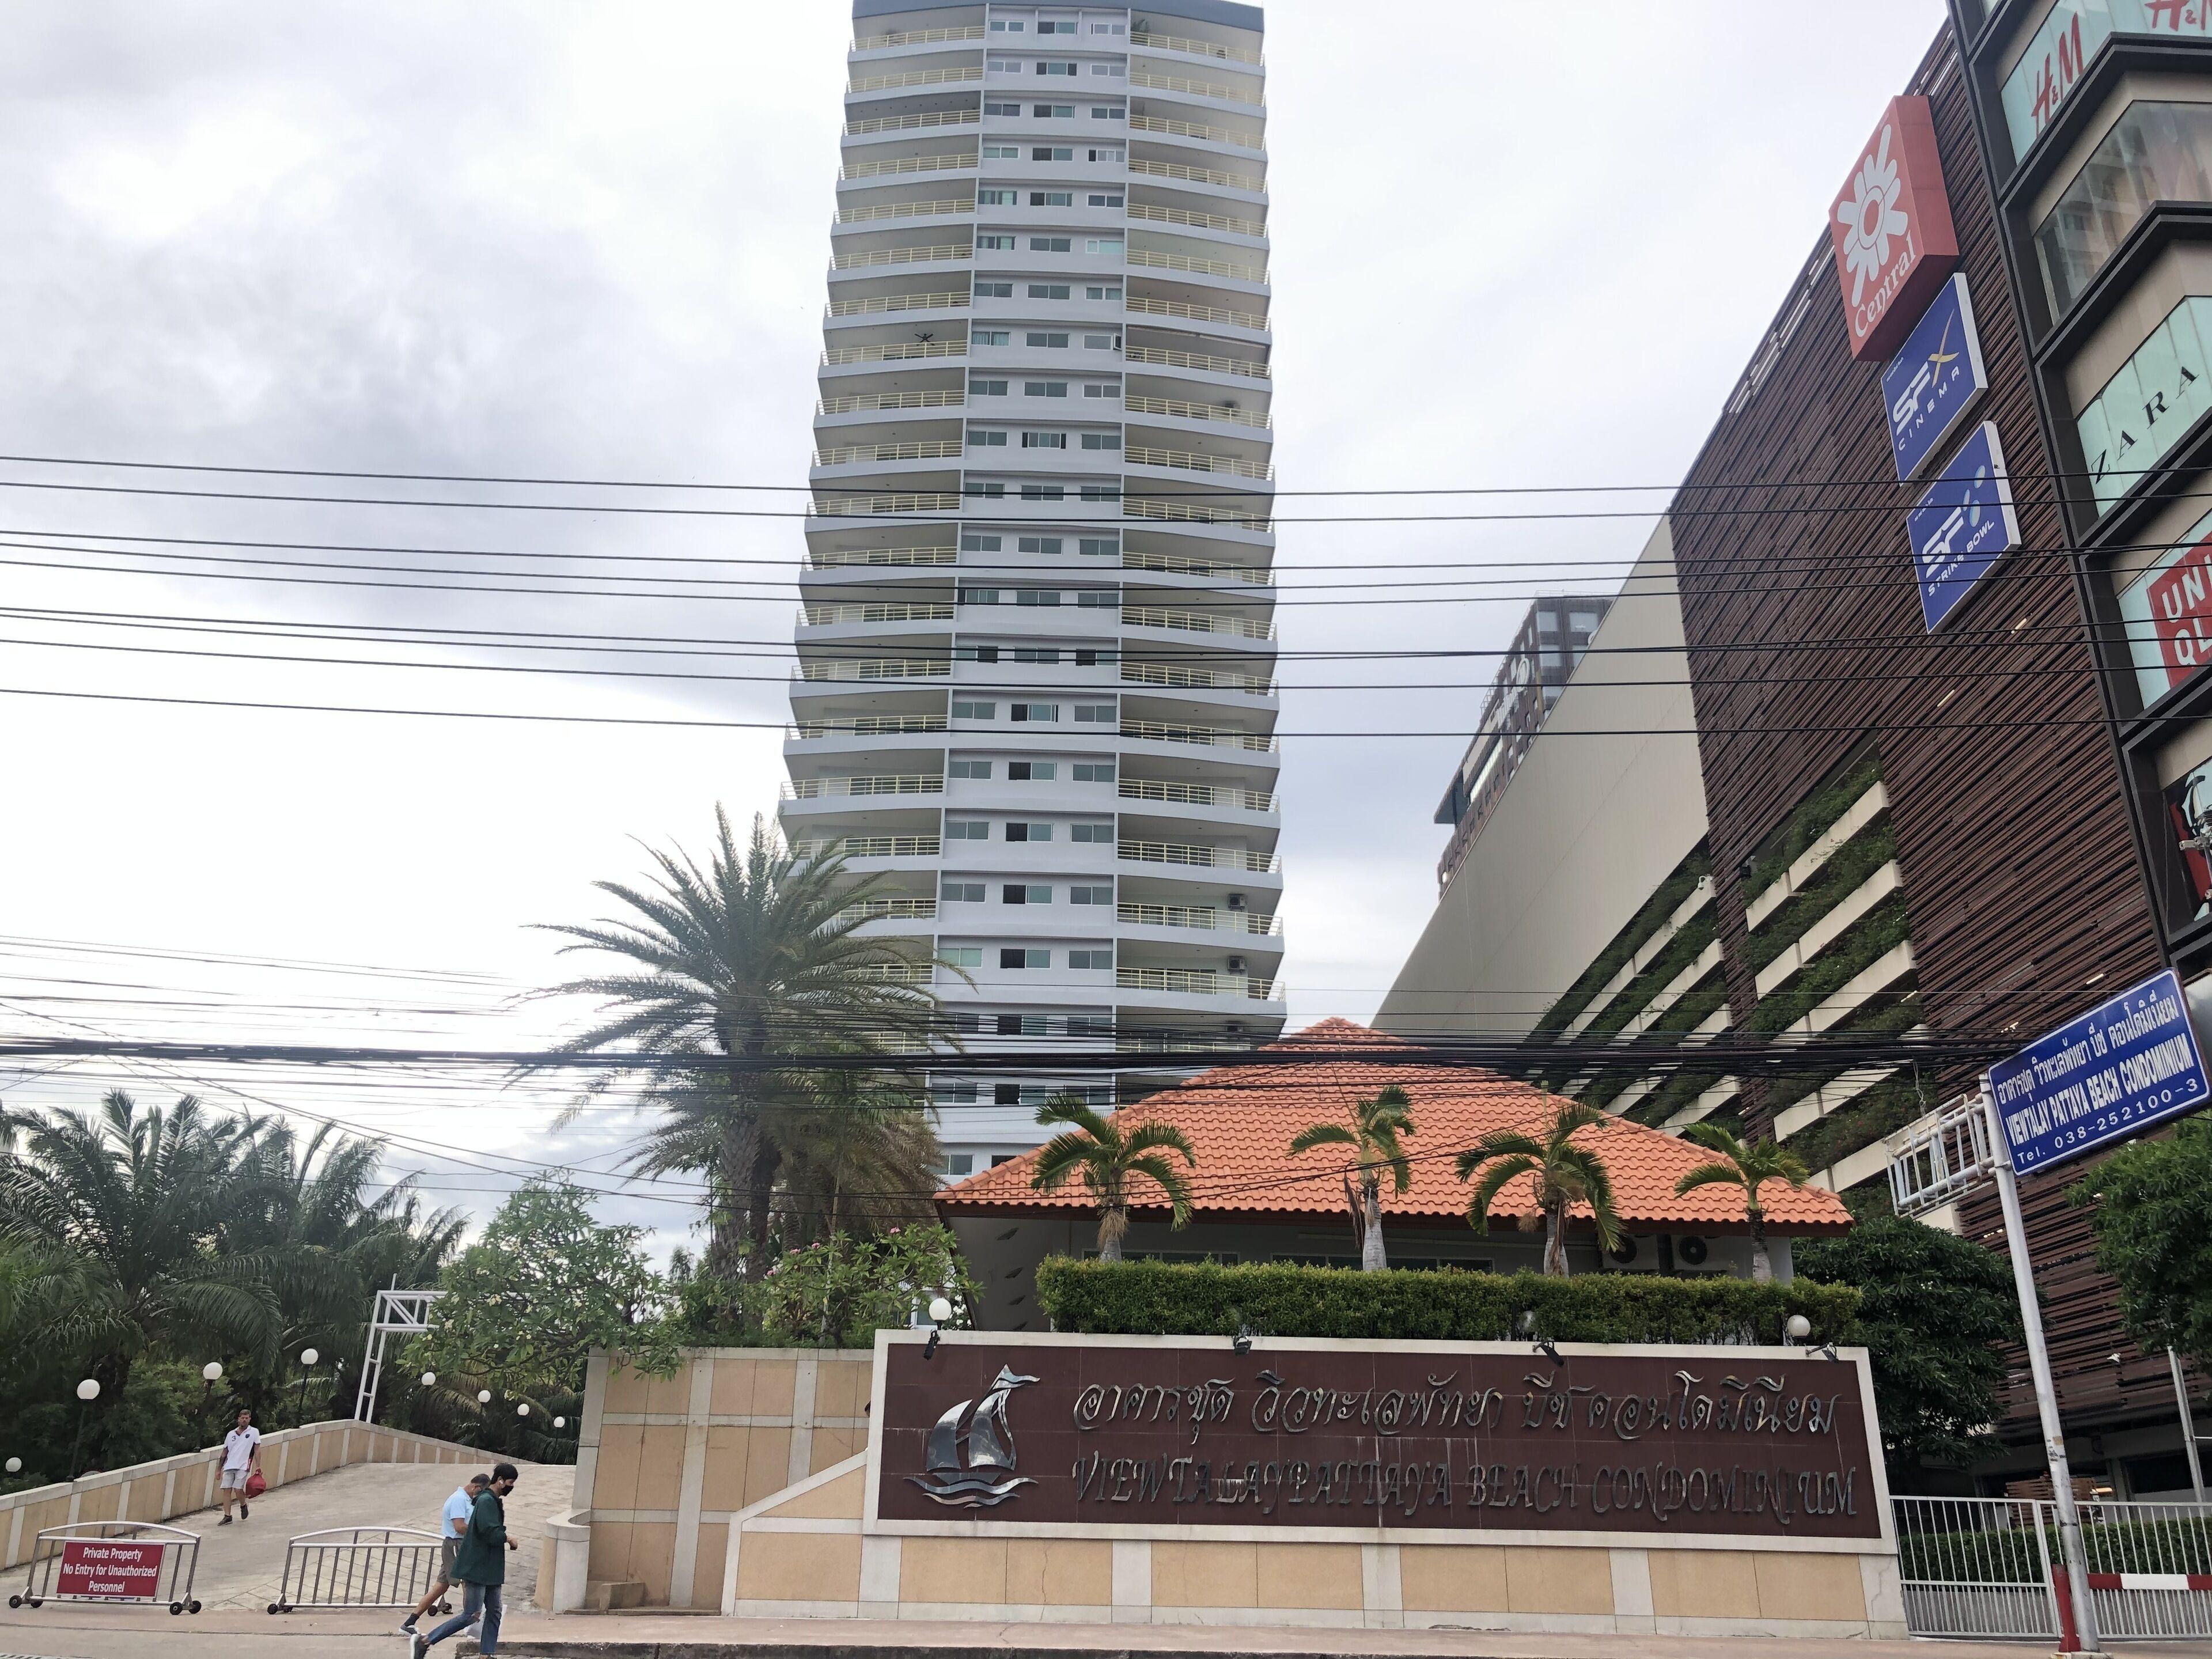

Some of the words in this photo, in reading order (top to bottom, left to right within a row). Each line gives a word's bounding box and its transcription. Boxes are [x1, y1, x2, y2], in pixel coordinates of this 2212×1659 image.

[1855, 229, 1916, 338] Central
[1898, 365, 1960, 451] CINEMA
[2090, 366, 2200, 485] ZARA
[1922, 506, 1964, 579] SF
[1927, 551, 1965, 597] STRIKE
[1966, 520, 1995, 554] BOWL
[1997, 1068, 2036, 1105] อาคารชุด
[2031, 1037, 2092, 1085] วิวทะเลพัทยา
[2088, 1022, 2108, 1058] บีช
[2108, 989, 2180, 1050] คอนโดมิเนียม
[2005, 1099, 2052, 1146] VIEWTALAY
[2048, 1082, 2092, 1128] PATTAYA
[2086, 1066, 2123, 1111] BEACH
[2119, 1032, 2195, 1095] CONDOMINIUM
[2017, 1146, 2046, 1164] Tel.
[1073, 1377, 1236, 1446] อาคารชุด
[1251, 1369, 1504, 1435] วิวทะเลพัทยา
[1521, 1369, 1596, 1429] บีช
[1588, 1370, 1842, 1440] คอนโดมิเนียม
[1466, 1462, 1581, 1513] BEACH
[1592, 1460, 1857, 1524] CONDOMINIUM
[63, 1563, 74, 1574] No
[74, 1563, 96, 1577] Entry
[95, 1563, 107, 1577] for
[108, 1564, 157, 1577] Unauthorized
[83, 1547, 109, 1559] Private
[110, 1548, 143, 1562] Property
[88, 1580, 126, 1593] Personnel
